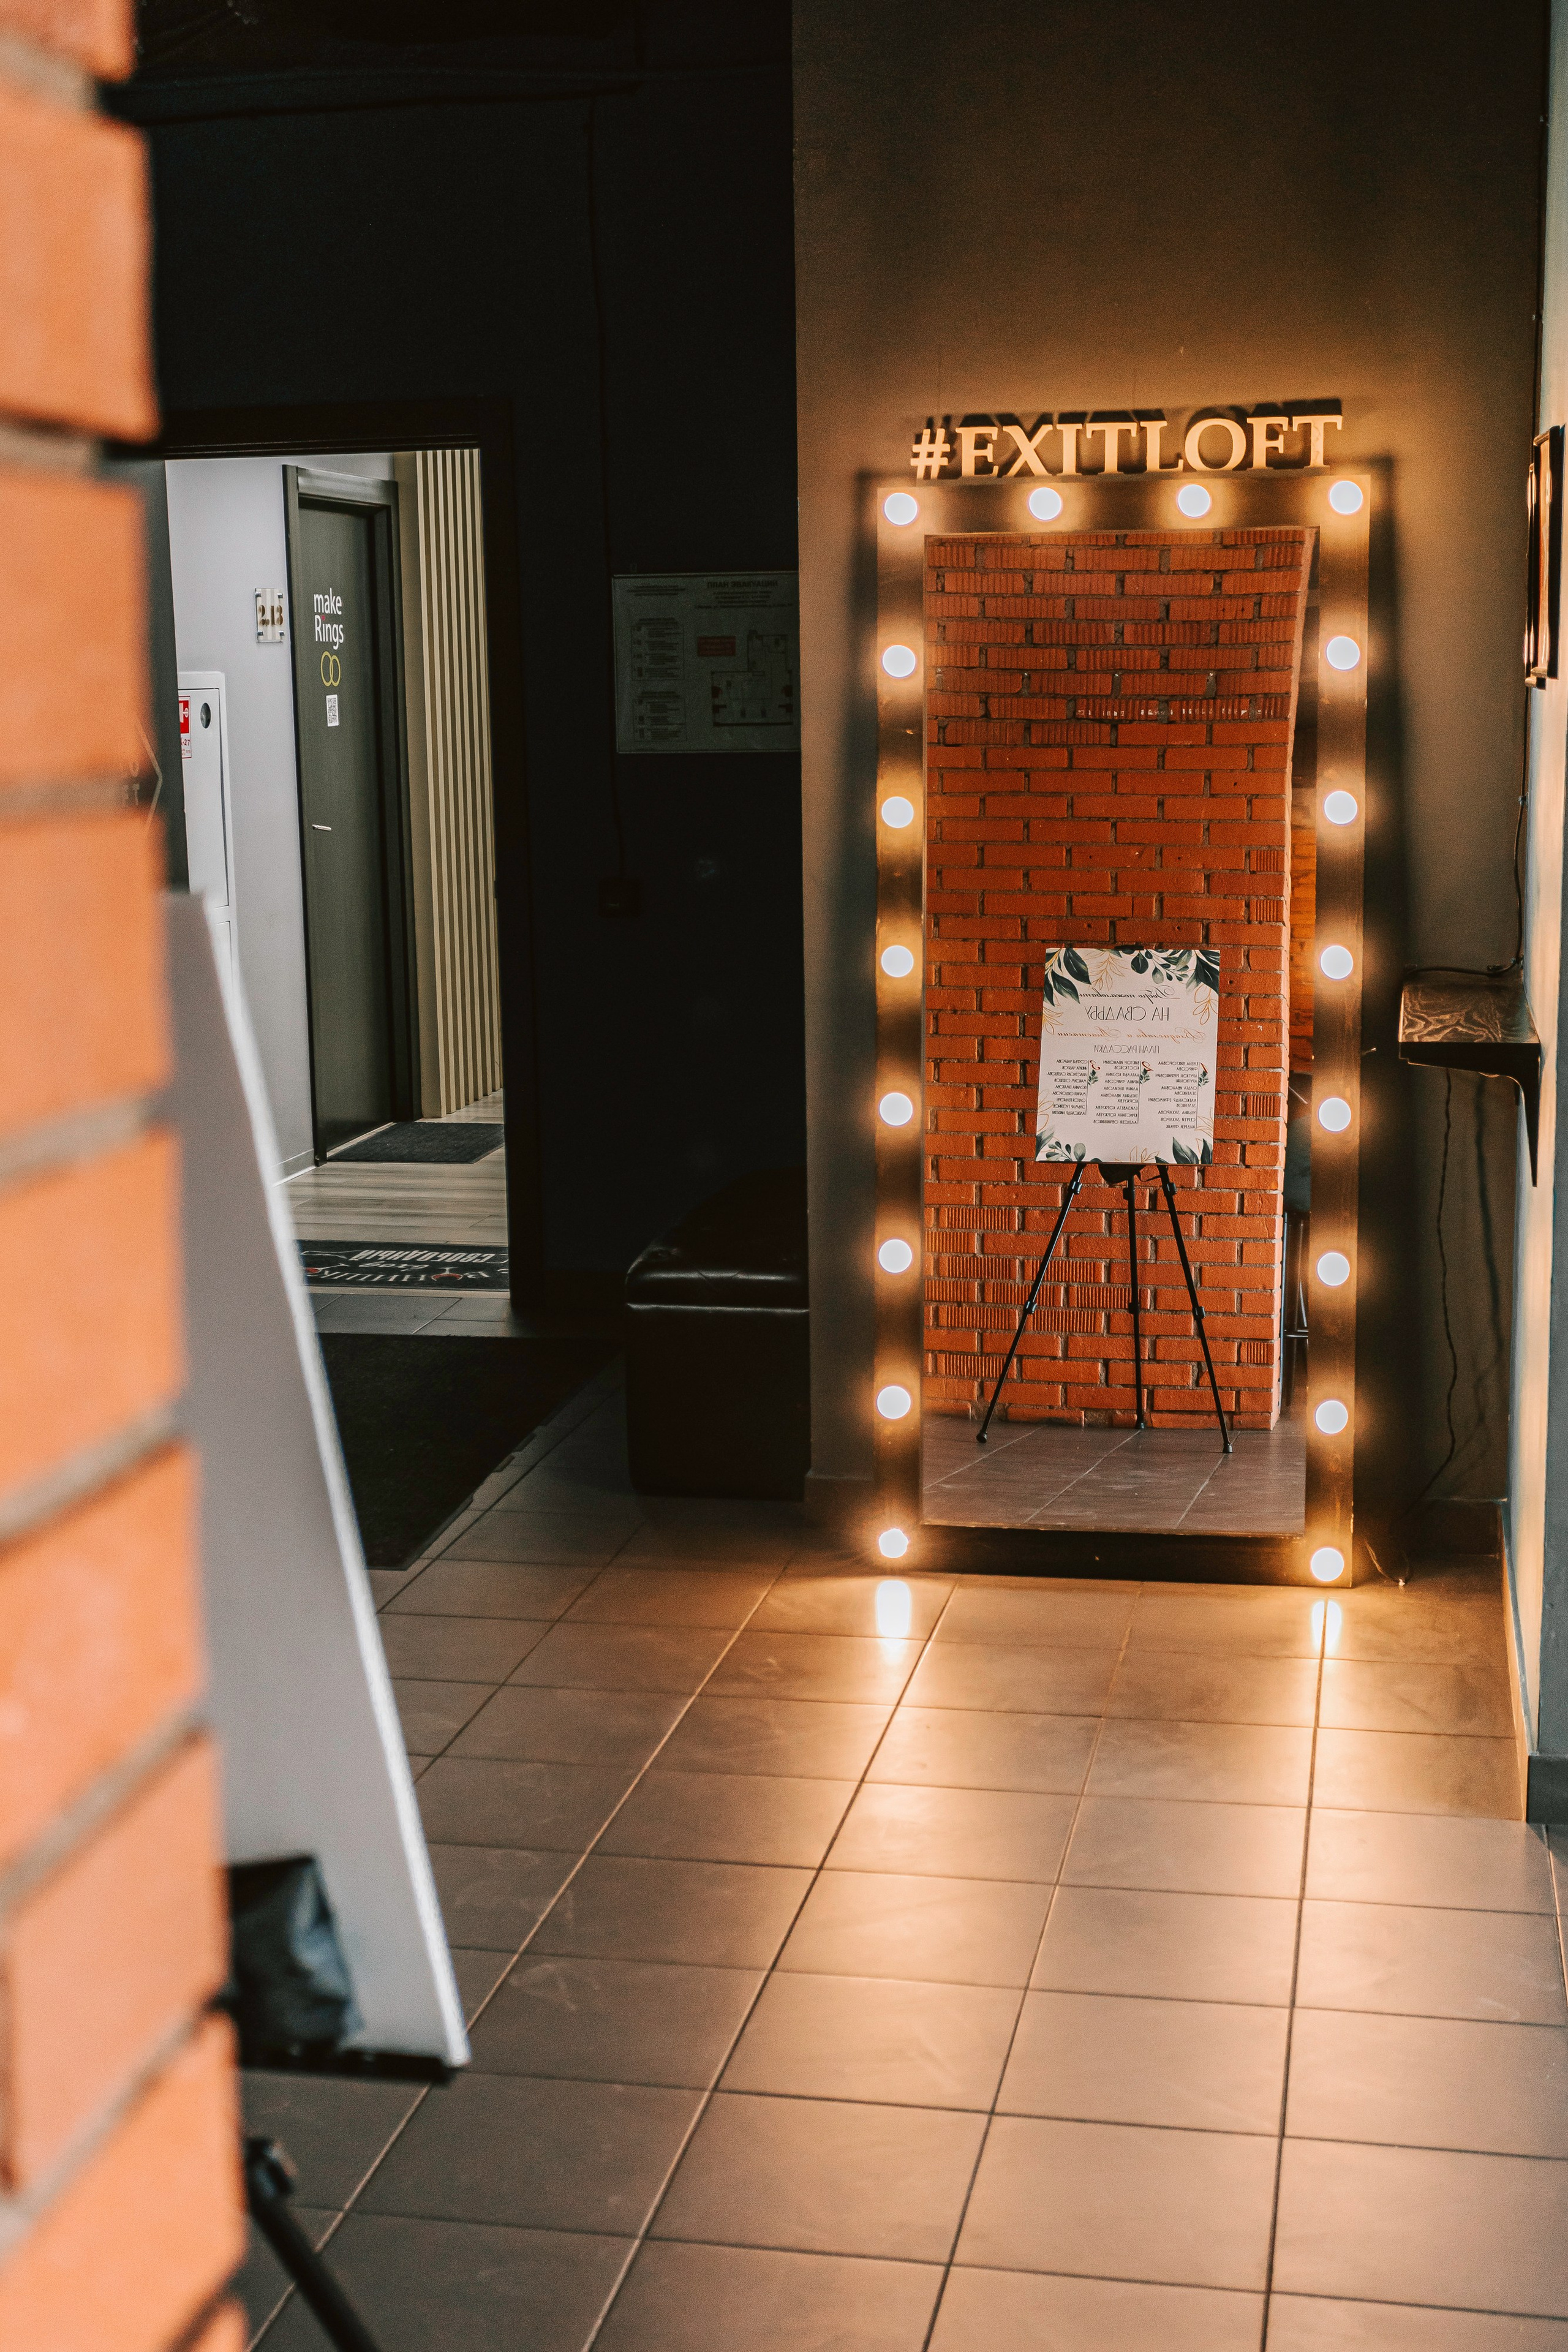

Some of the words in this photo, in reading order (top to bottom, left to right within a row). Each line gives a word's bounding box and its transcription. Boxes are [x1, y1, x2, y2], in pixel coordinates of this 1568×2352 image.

[910, 415, 1342, 480] #EXITLOFT
[314, 587, 342, 615] make
[315, 615, 344, 650] Rings
[349, 1250, 496, 1263] СВОБОДНЫЙ
